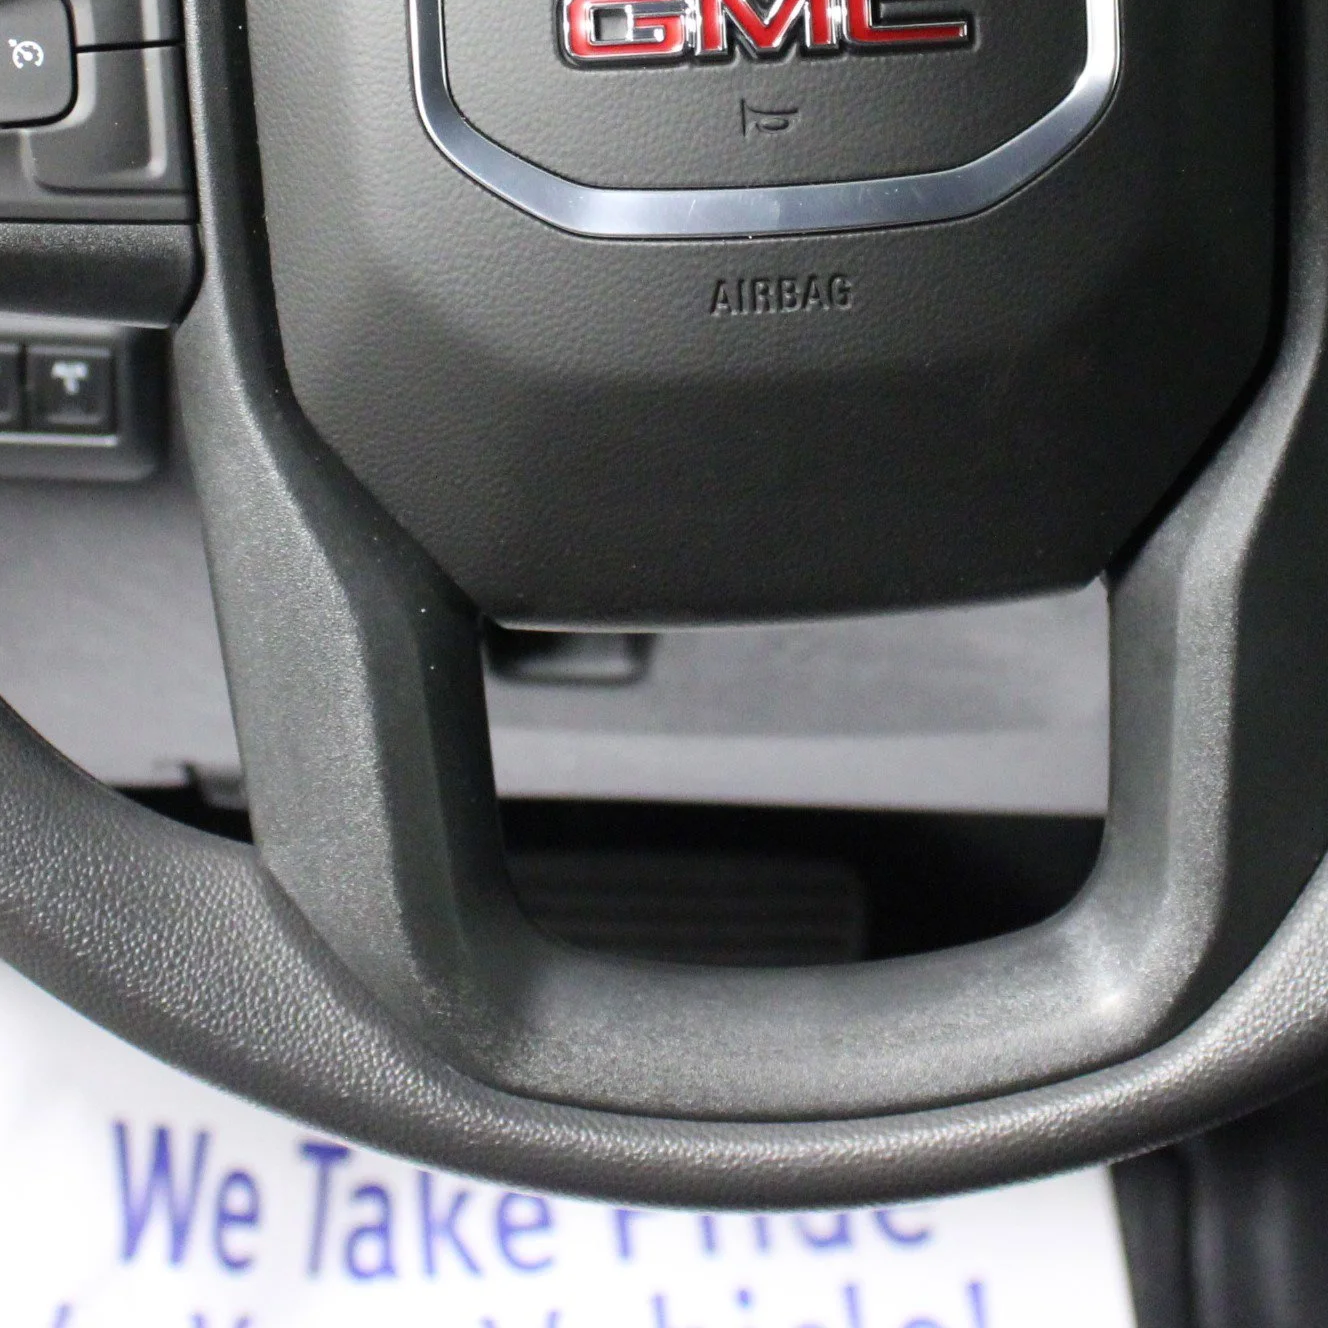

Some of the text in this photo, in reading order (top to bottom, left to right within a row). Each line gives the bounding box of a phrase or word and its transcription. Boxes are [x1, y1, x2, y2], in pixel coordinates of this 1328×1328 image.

[709, 273, 853, 317] AIRBAG
[114, 1119, 556, 1282] We Take
